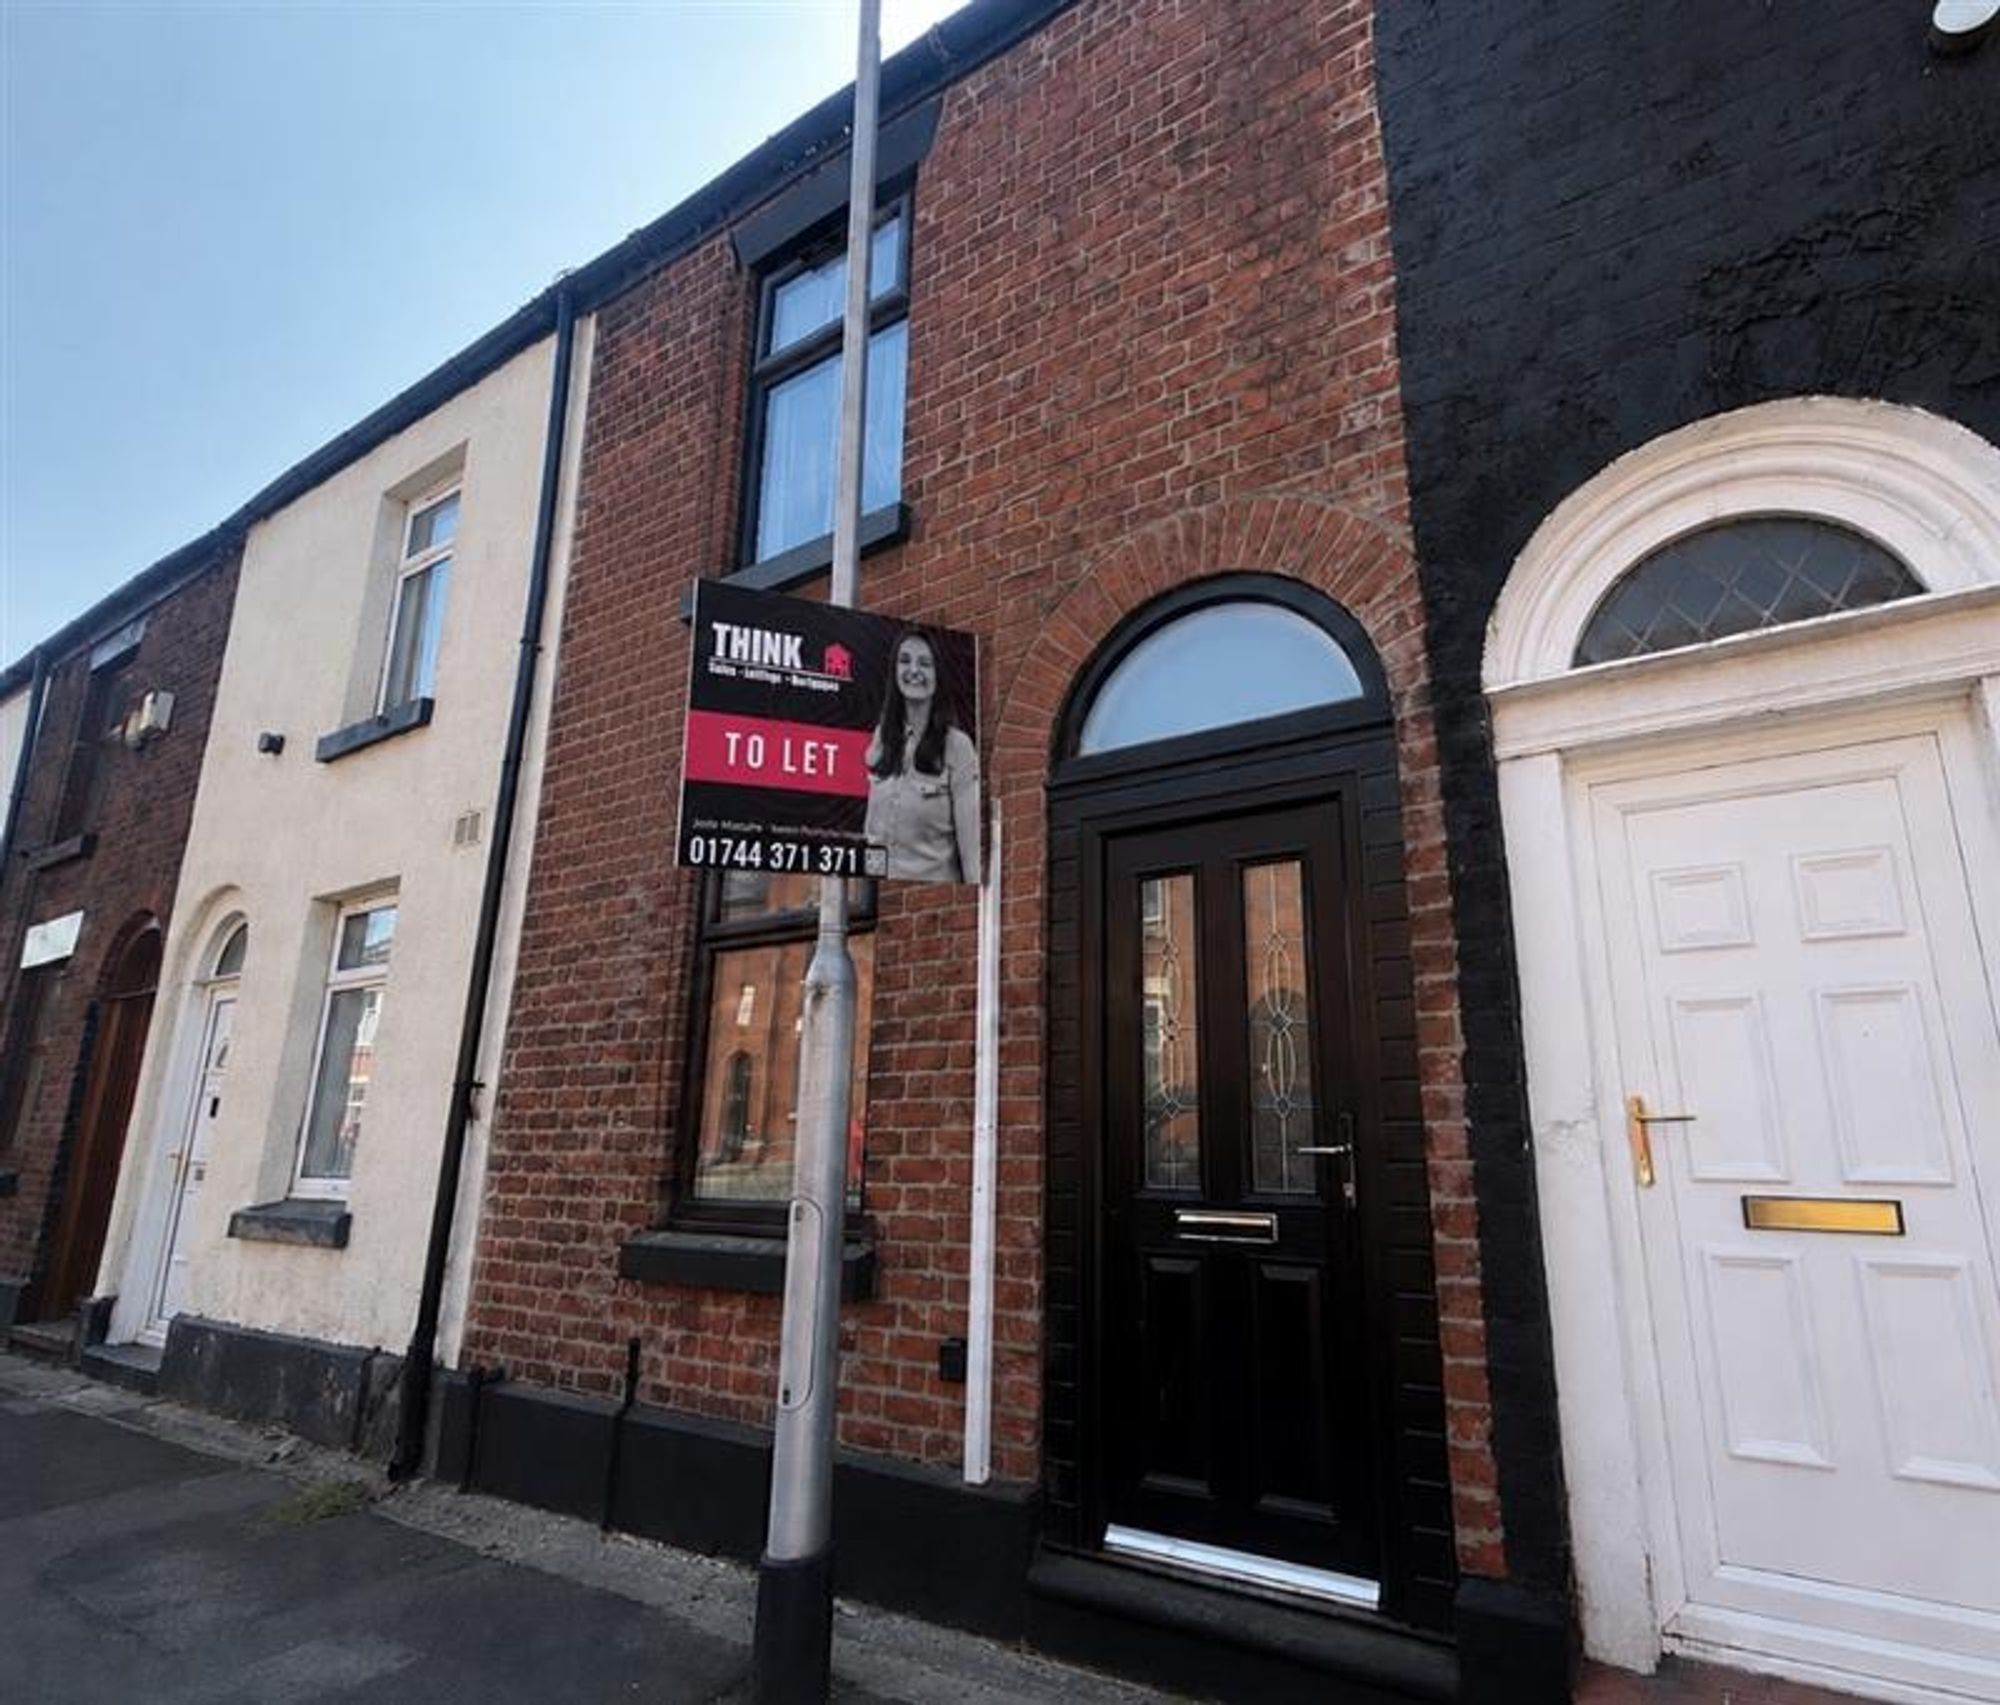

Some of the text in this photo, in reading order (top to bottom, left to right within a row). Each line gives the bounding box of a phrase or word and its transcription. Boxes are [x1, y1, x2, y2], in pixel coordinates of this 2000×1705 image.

[712, 621, 803, 669] THINK
[725, 732, 839, 776] TO LET
[689, 836, 857, 873] 01744 371 371
